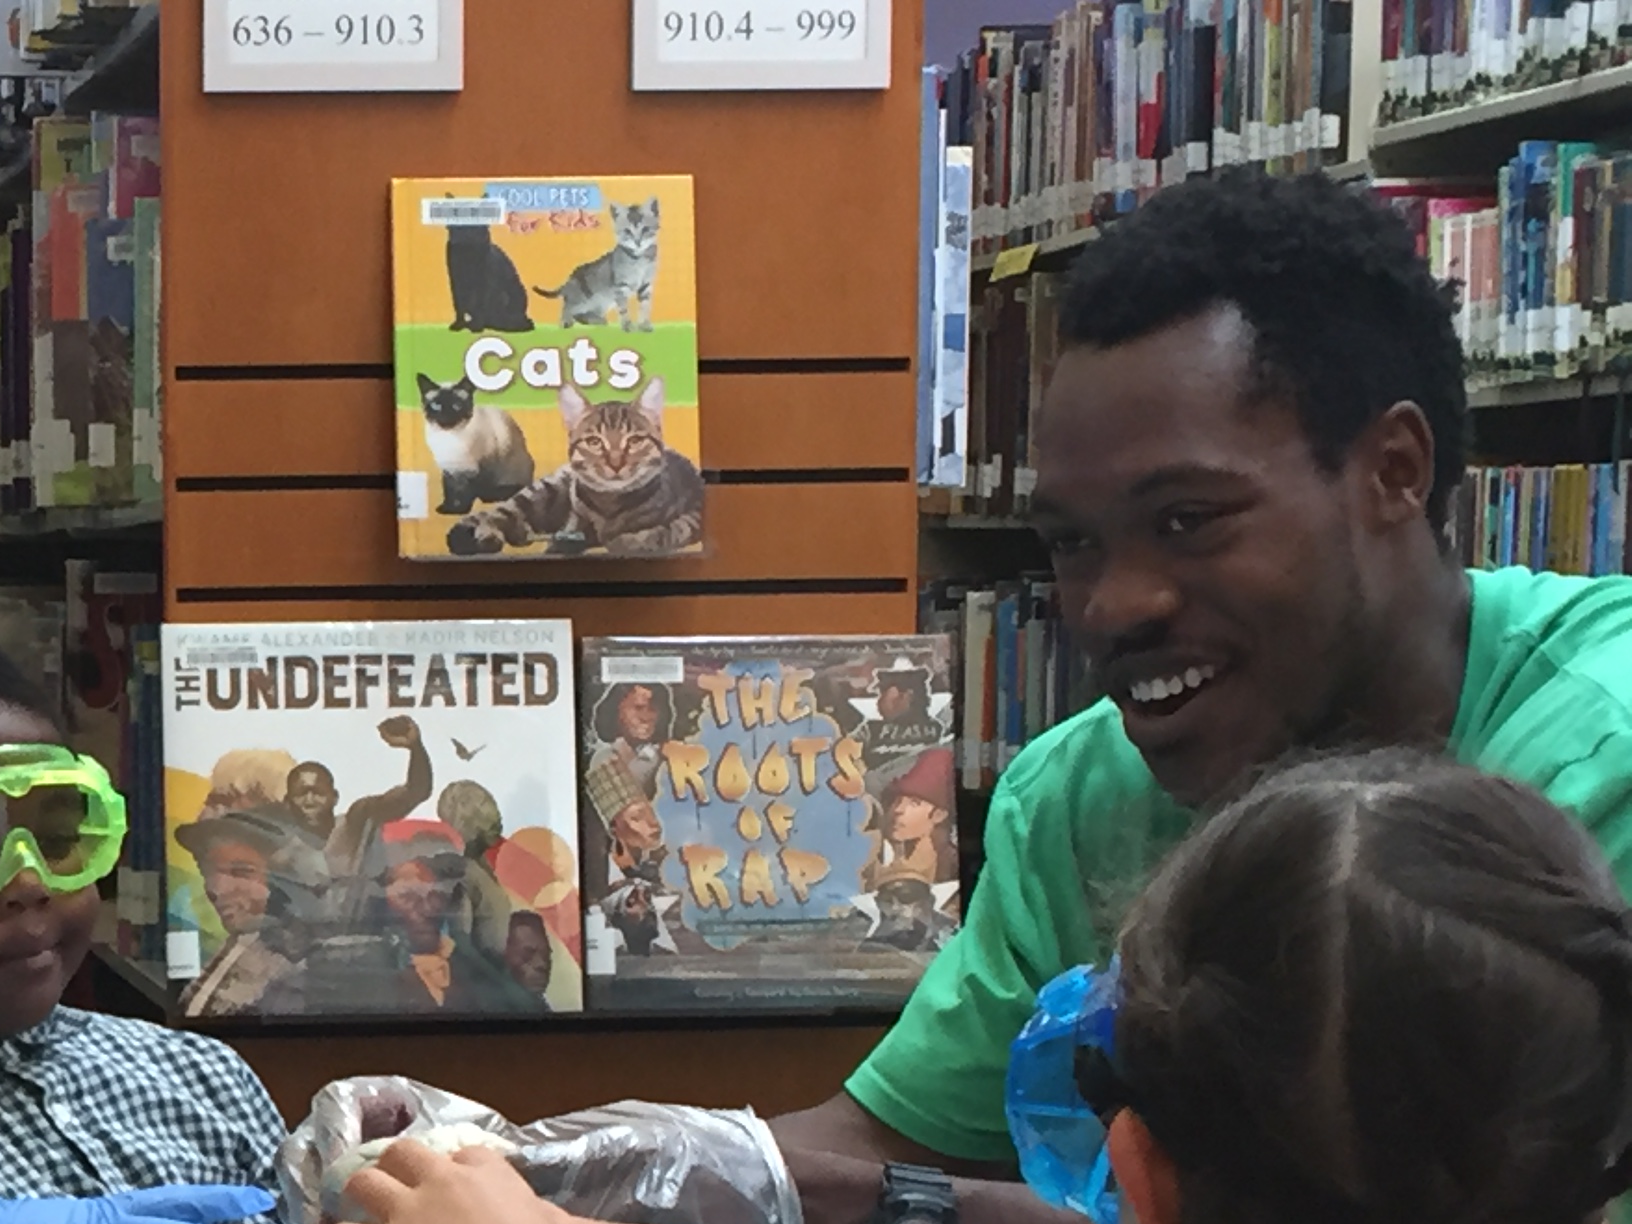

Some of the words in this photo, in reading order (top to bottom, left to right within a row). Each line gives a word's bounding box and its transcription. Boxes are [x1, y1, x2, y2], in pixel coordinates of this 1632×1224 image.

[232, 14, 293, 47] 636
[334, 13, 425, 46] 910.3
[663, 10, 755, 42] 910.4
[796, 9, 857, 41] 999
[549, 187, 590, 207] PETS
[464, 336, 641, 392] Cats
[474, 628, 555, 645] NELSON
[206, 651, 560, 711] UNDEFEATED
[697, 668, 816, 731] THE
[660, 735, 866, 806] ROOTS
[735, 799, 798, 845] OF
[678, 842, 832, 911] RAP
